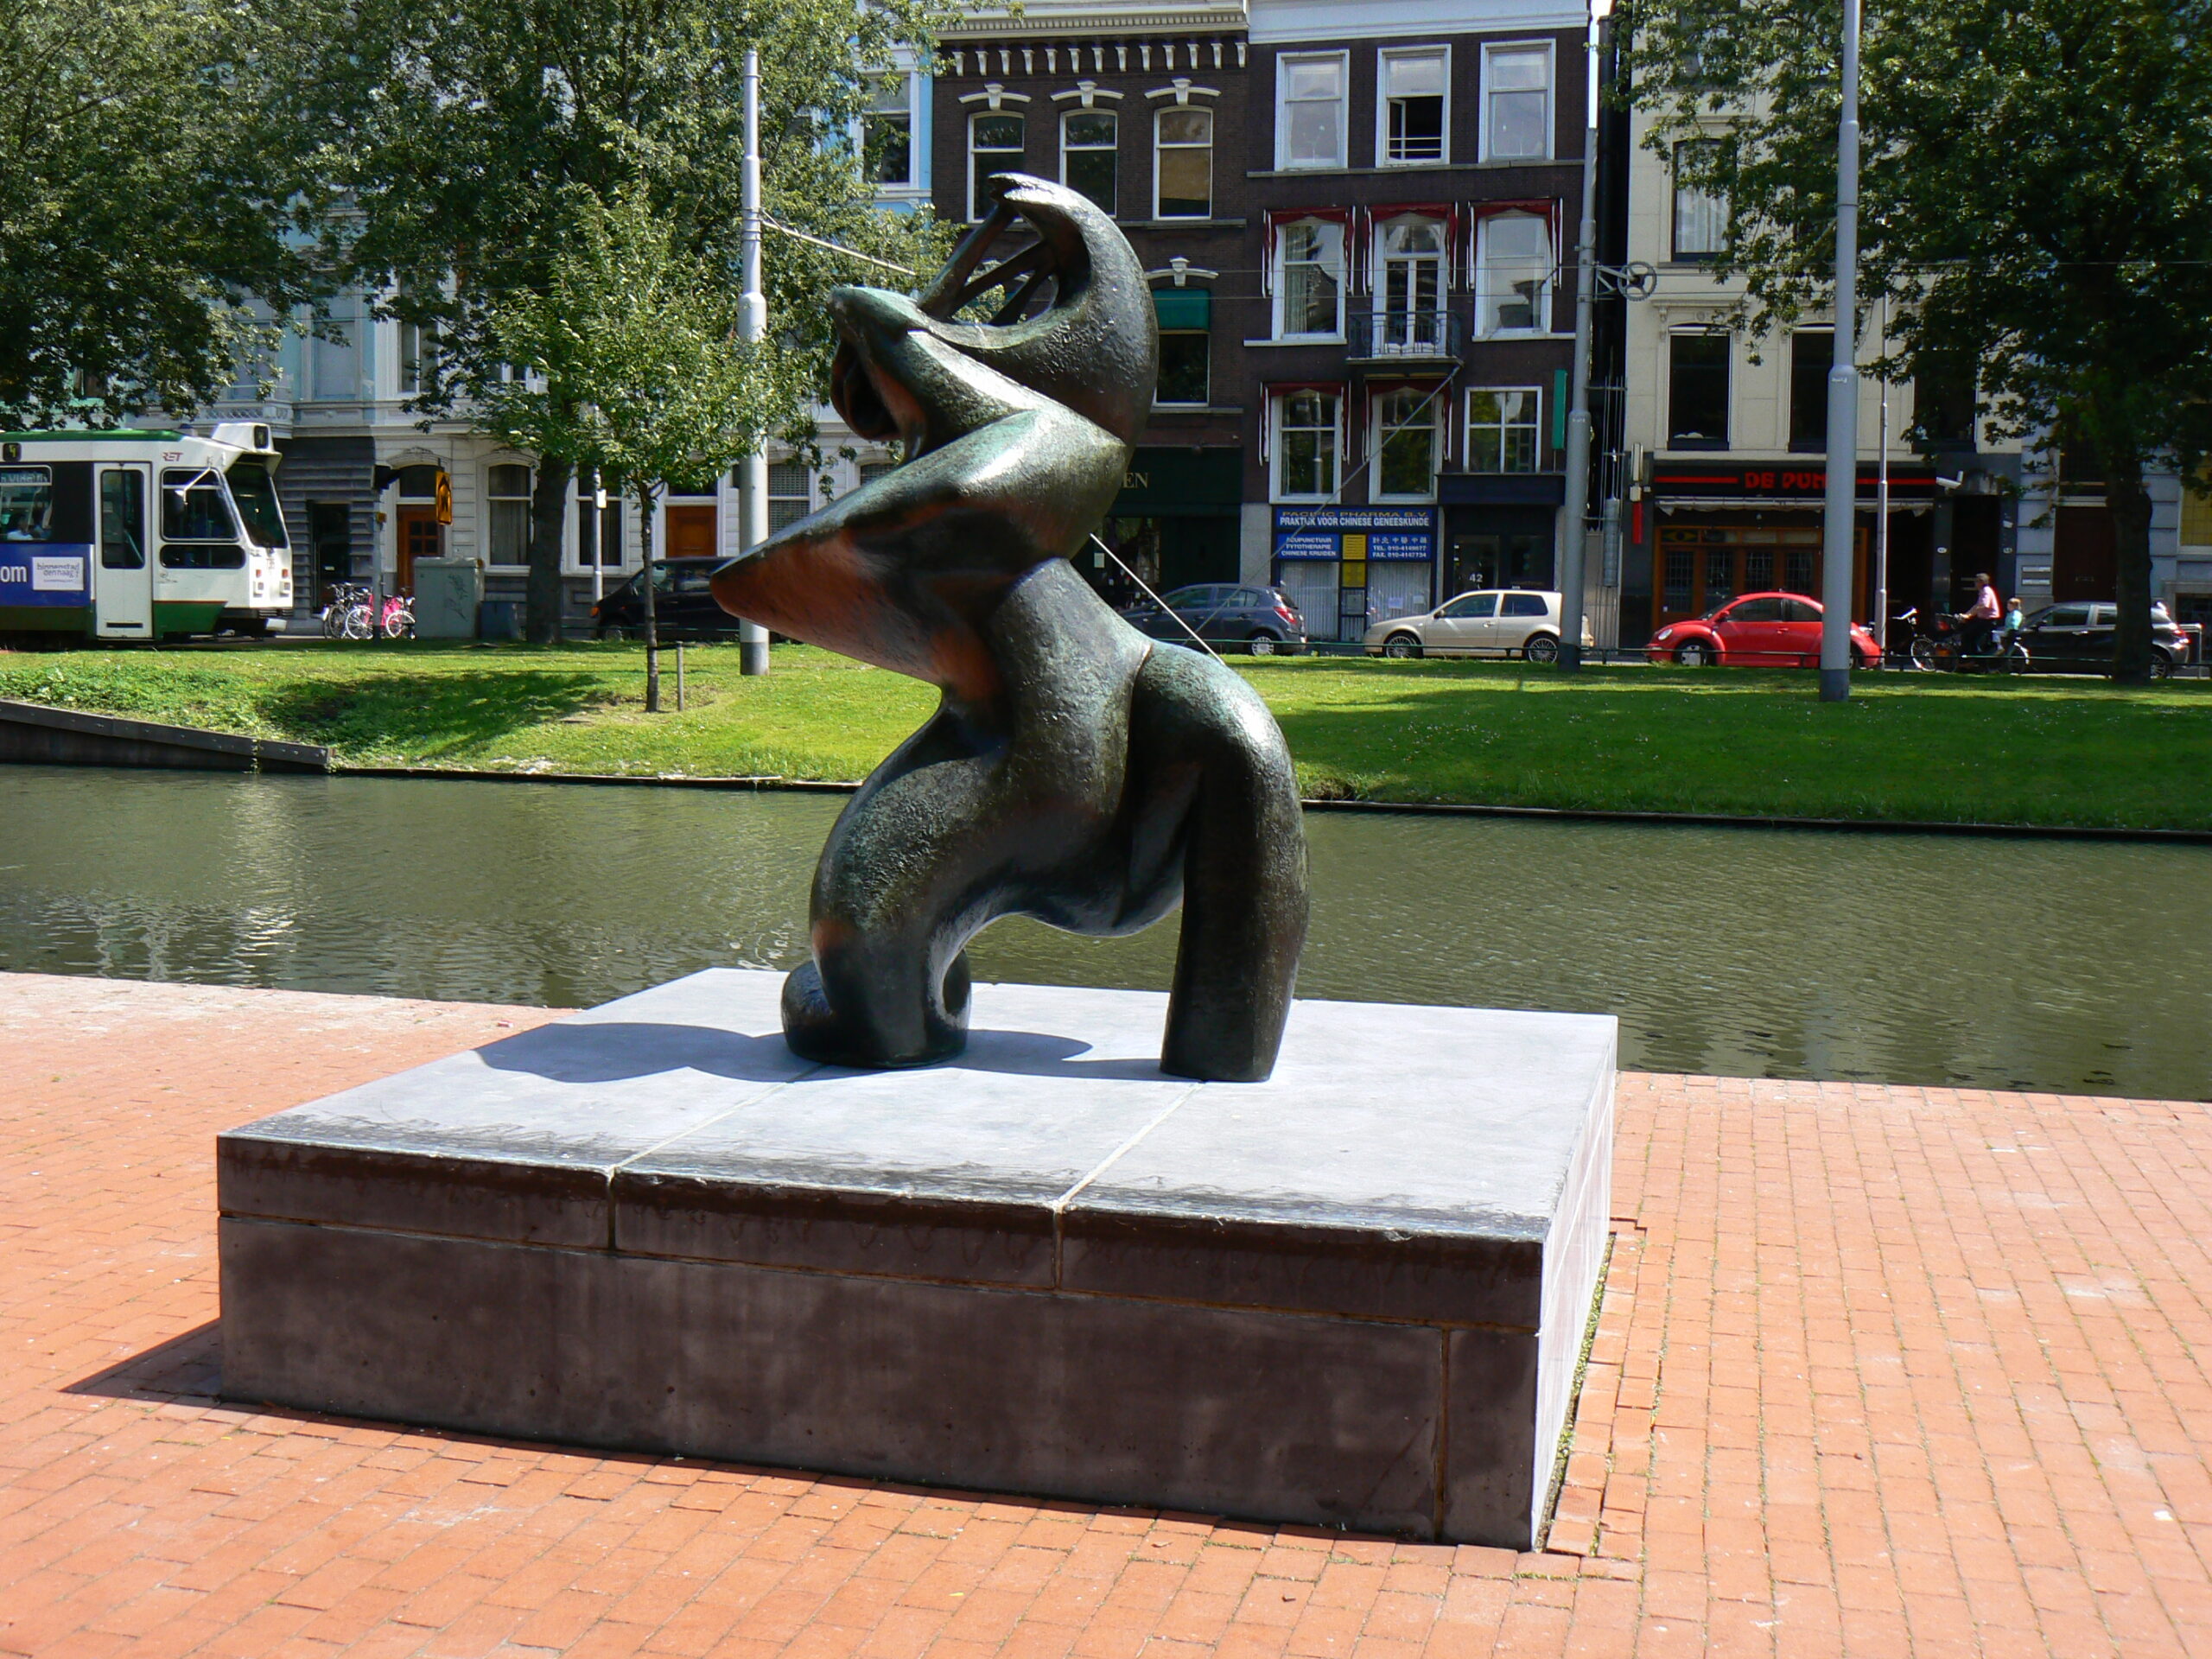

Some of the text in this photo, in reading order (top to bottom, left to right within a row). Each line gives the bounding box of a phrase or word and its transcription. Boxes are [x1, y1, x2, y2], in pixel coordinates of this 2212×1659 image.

[162, 452, 184, 461] RET
[1745, 472, 1777, 489] DE
[1317, 517, 1338, 526] VOOR
[1339, 517, 1372, 526] CHINESE
[1373, 517, 1429, 526] GENEESKUNDE
[1469, 573, 1484, 583] 42
